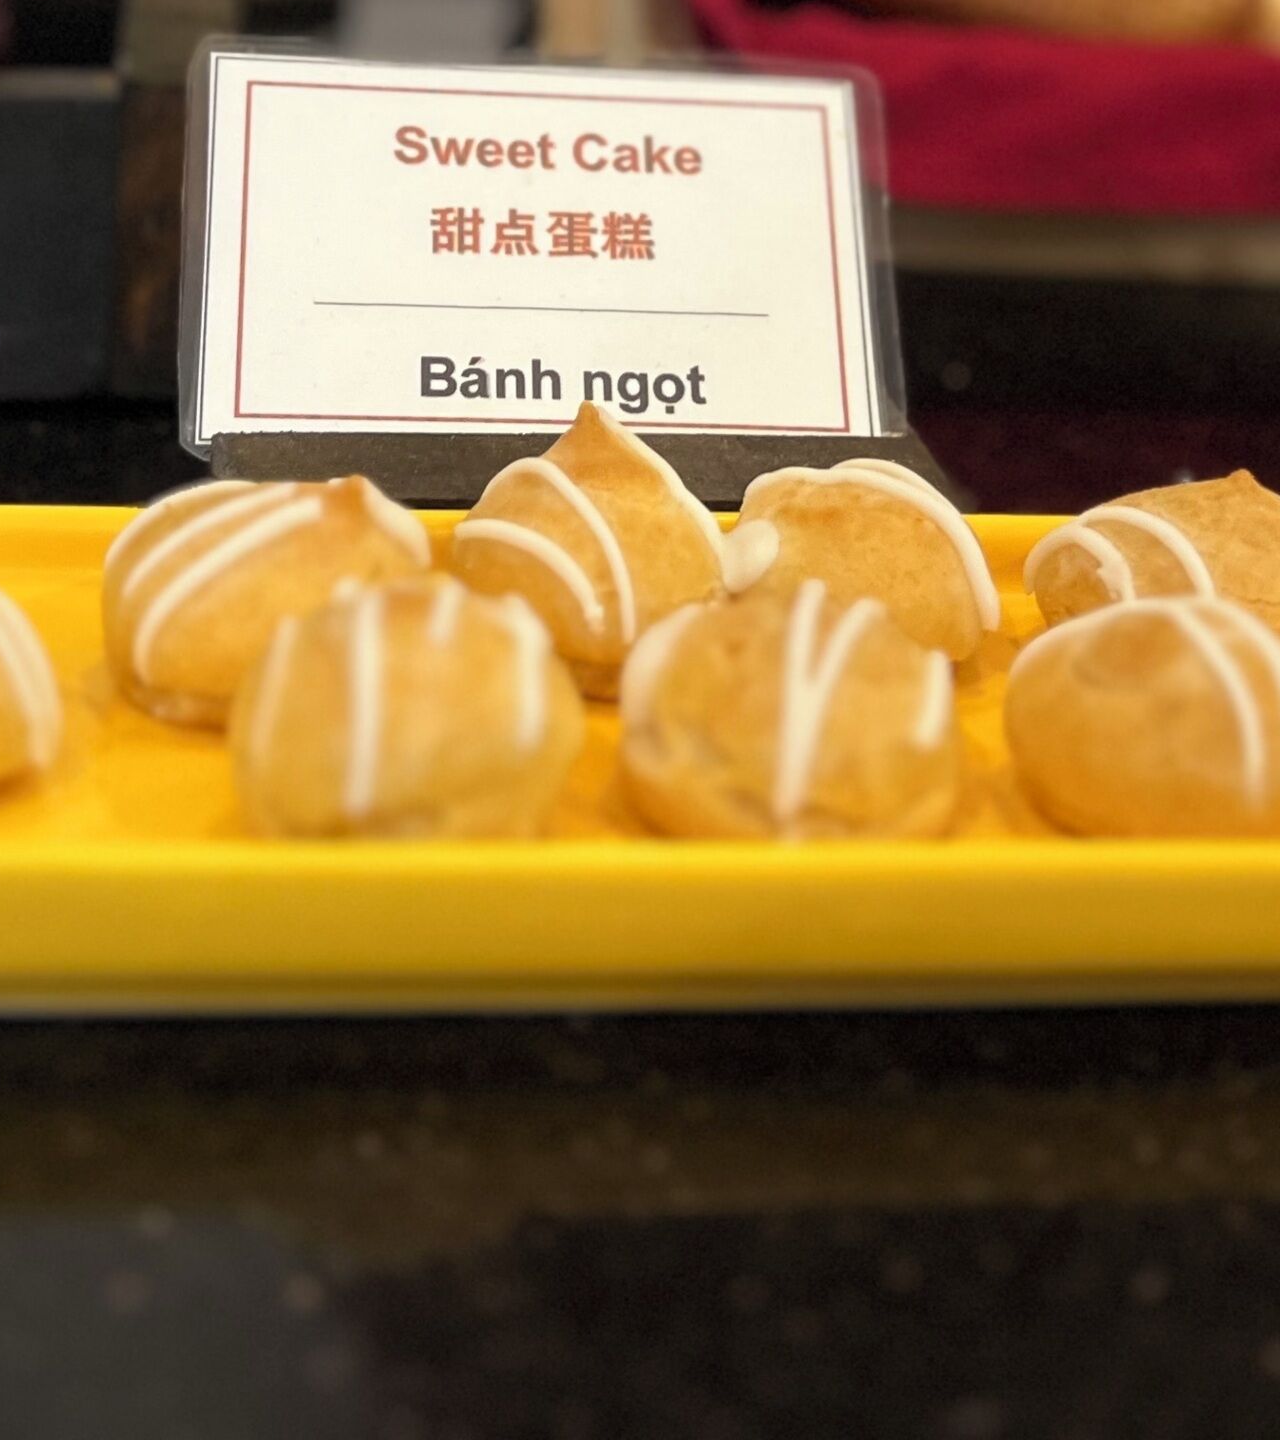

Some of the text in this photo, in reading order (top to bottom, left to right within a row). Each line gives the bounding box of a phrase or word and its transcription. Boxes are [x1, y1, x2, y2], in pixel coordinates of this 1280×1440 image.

[393, 125, 703, 176] Sweet Cake
[429, 206, 656, 262] 甜点蛋糕
[419, 355, 708, 415] Bánh ngọt
